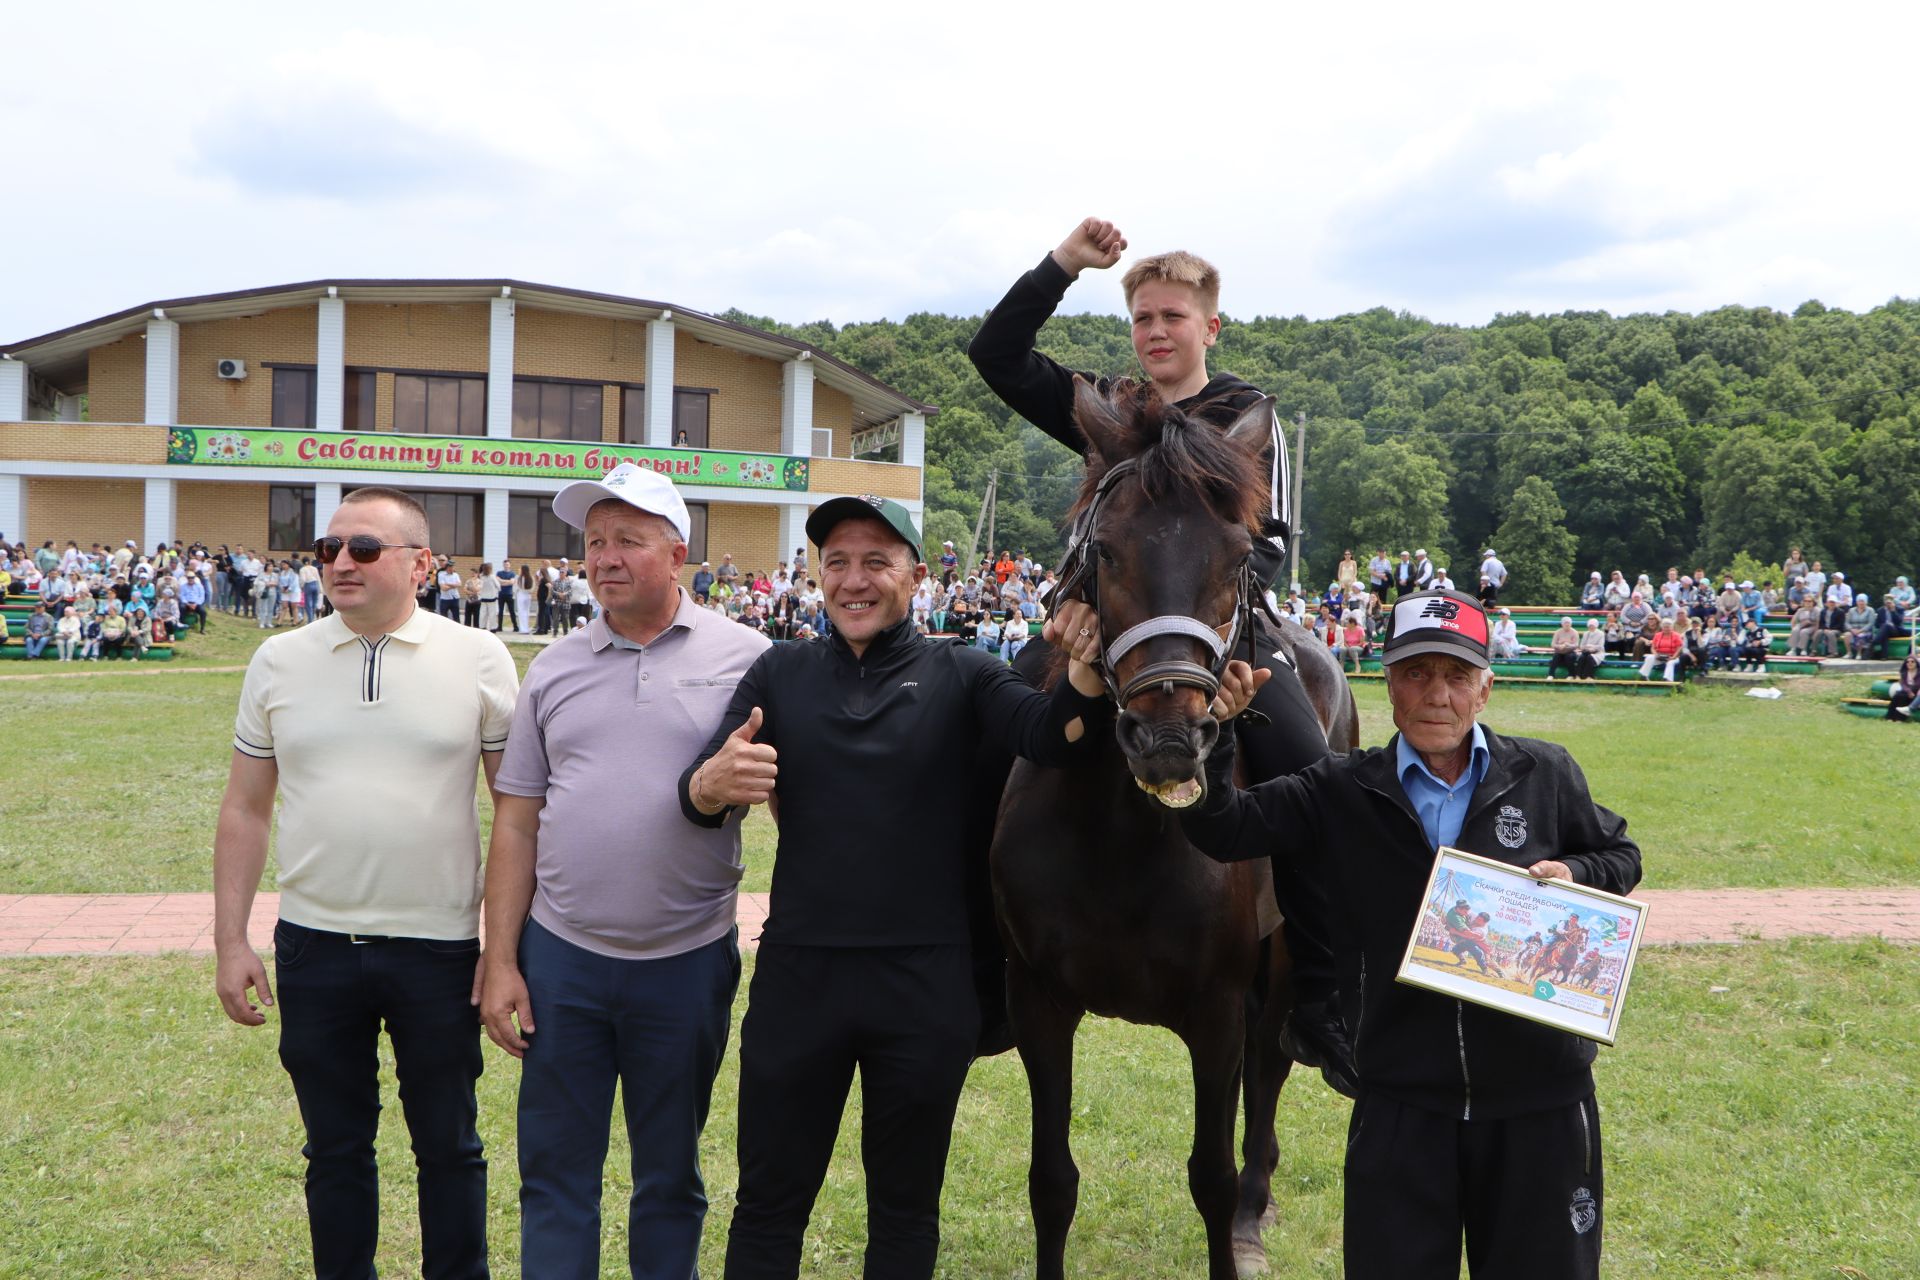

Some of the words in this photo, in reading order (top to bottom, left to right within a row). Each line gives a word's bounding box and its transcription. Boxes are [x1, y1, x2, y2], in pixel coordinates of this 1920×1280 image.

[297, 437, 463, 469] Сабантуй
[471, 449, 577, 470] котлы
[583, 448, 702, 476] бусын!
[1474, 881, 1504, 894] СКАЧКИ
[1505, 889, 1531, 902] СРЕДИ
[1532, 896, 1569, 912] РАБОЧИХ
[1498, 895, 1539, 912] ЛОШАДЕЙ
[1504, 914, 1518, 922] 000
[1507, 907, 1531, 917] МЕСТО
